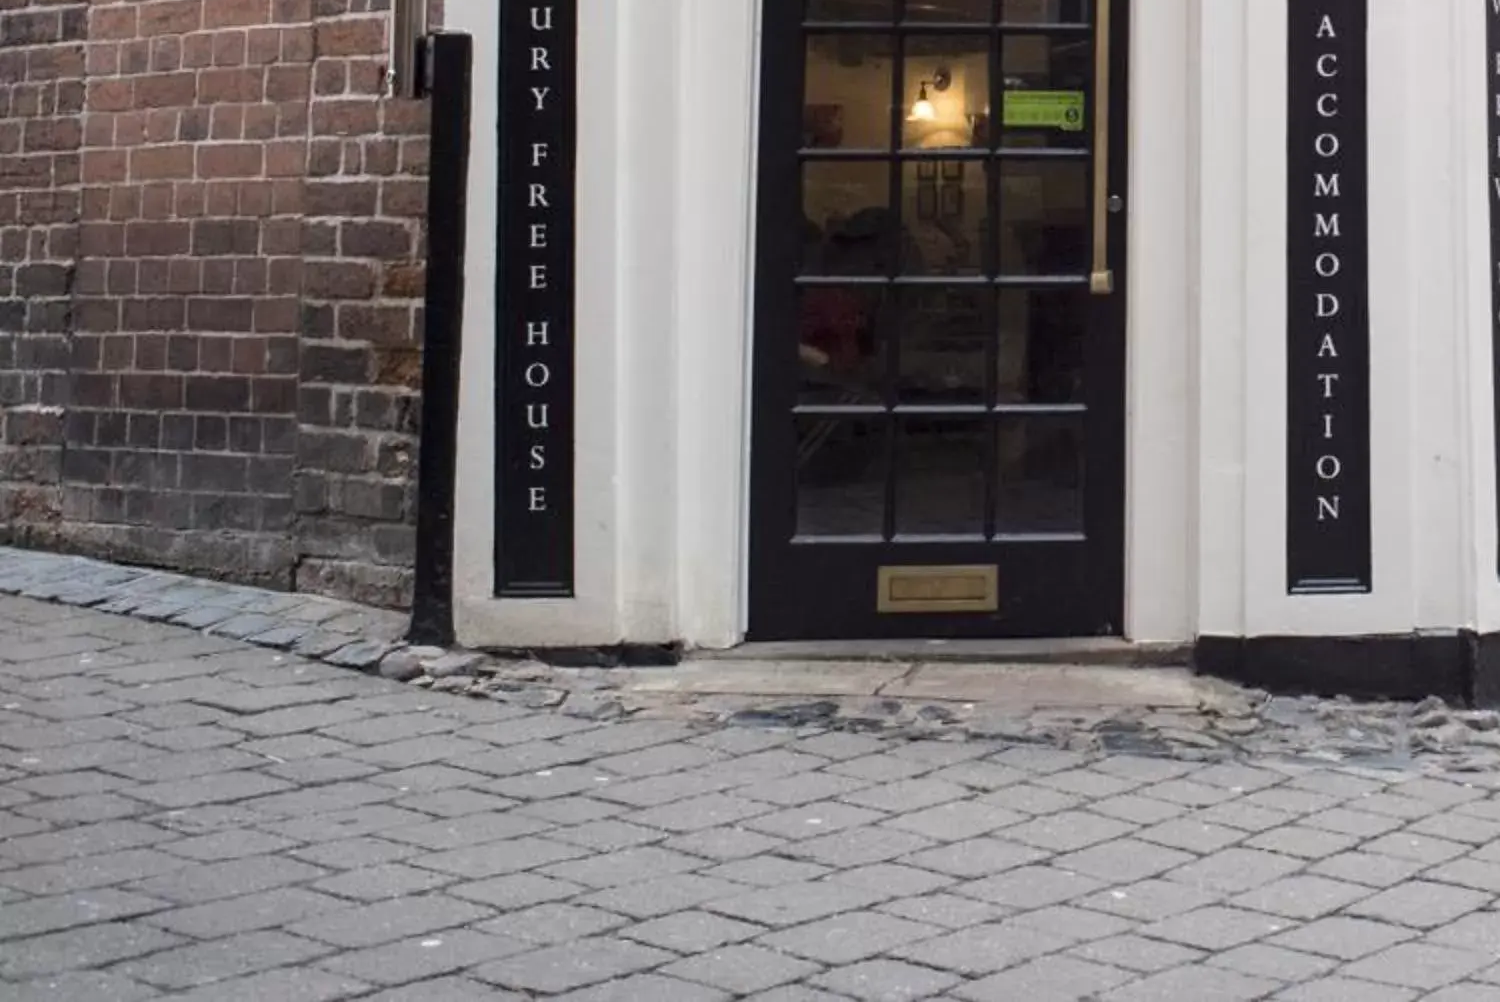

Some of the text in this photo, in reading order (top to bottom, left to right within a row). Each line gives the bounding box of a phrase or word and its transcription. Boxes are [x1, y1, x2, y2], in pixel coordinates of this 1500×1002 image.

[527, 142, 550, 290] FREE
[1313, 14, 1342, 521] ACCOMMODATION
[524, 321, 551, 512] HOUSE
